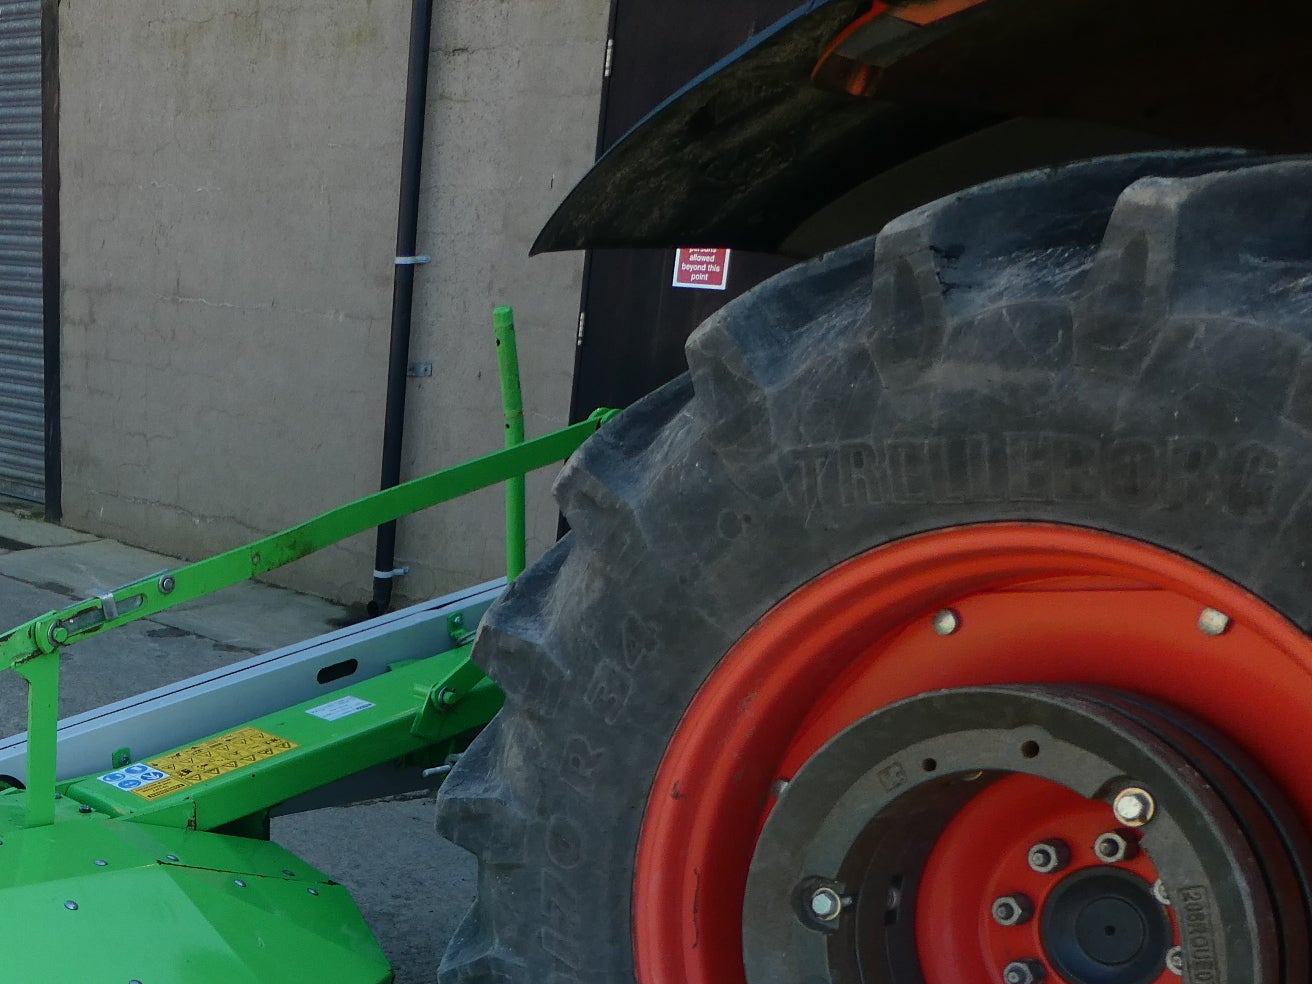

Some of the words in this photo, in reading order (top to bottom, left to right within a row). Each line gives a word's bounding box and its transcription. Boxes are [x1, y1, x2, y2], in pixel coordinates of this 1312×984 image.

[689, 254, 715, 262] allowed
[681, 263, 706, 272] beyond
[707, 264, 720, 272] this
[690, 273, 708, 281] point
[788, 432, 1280, 518] TRELLEBORG
[561, 734, 606, 790] R
